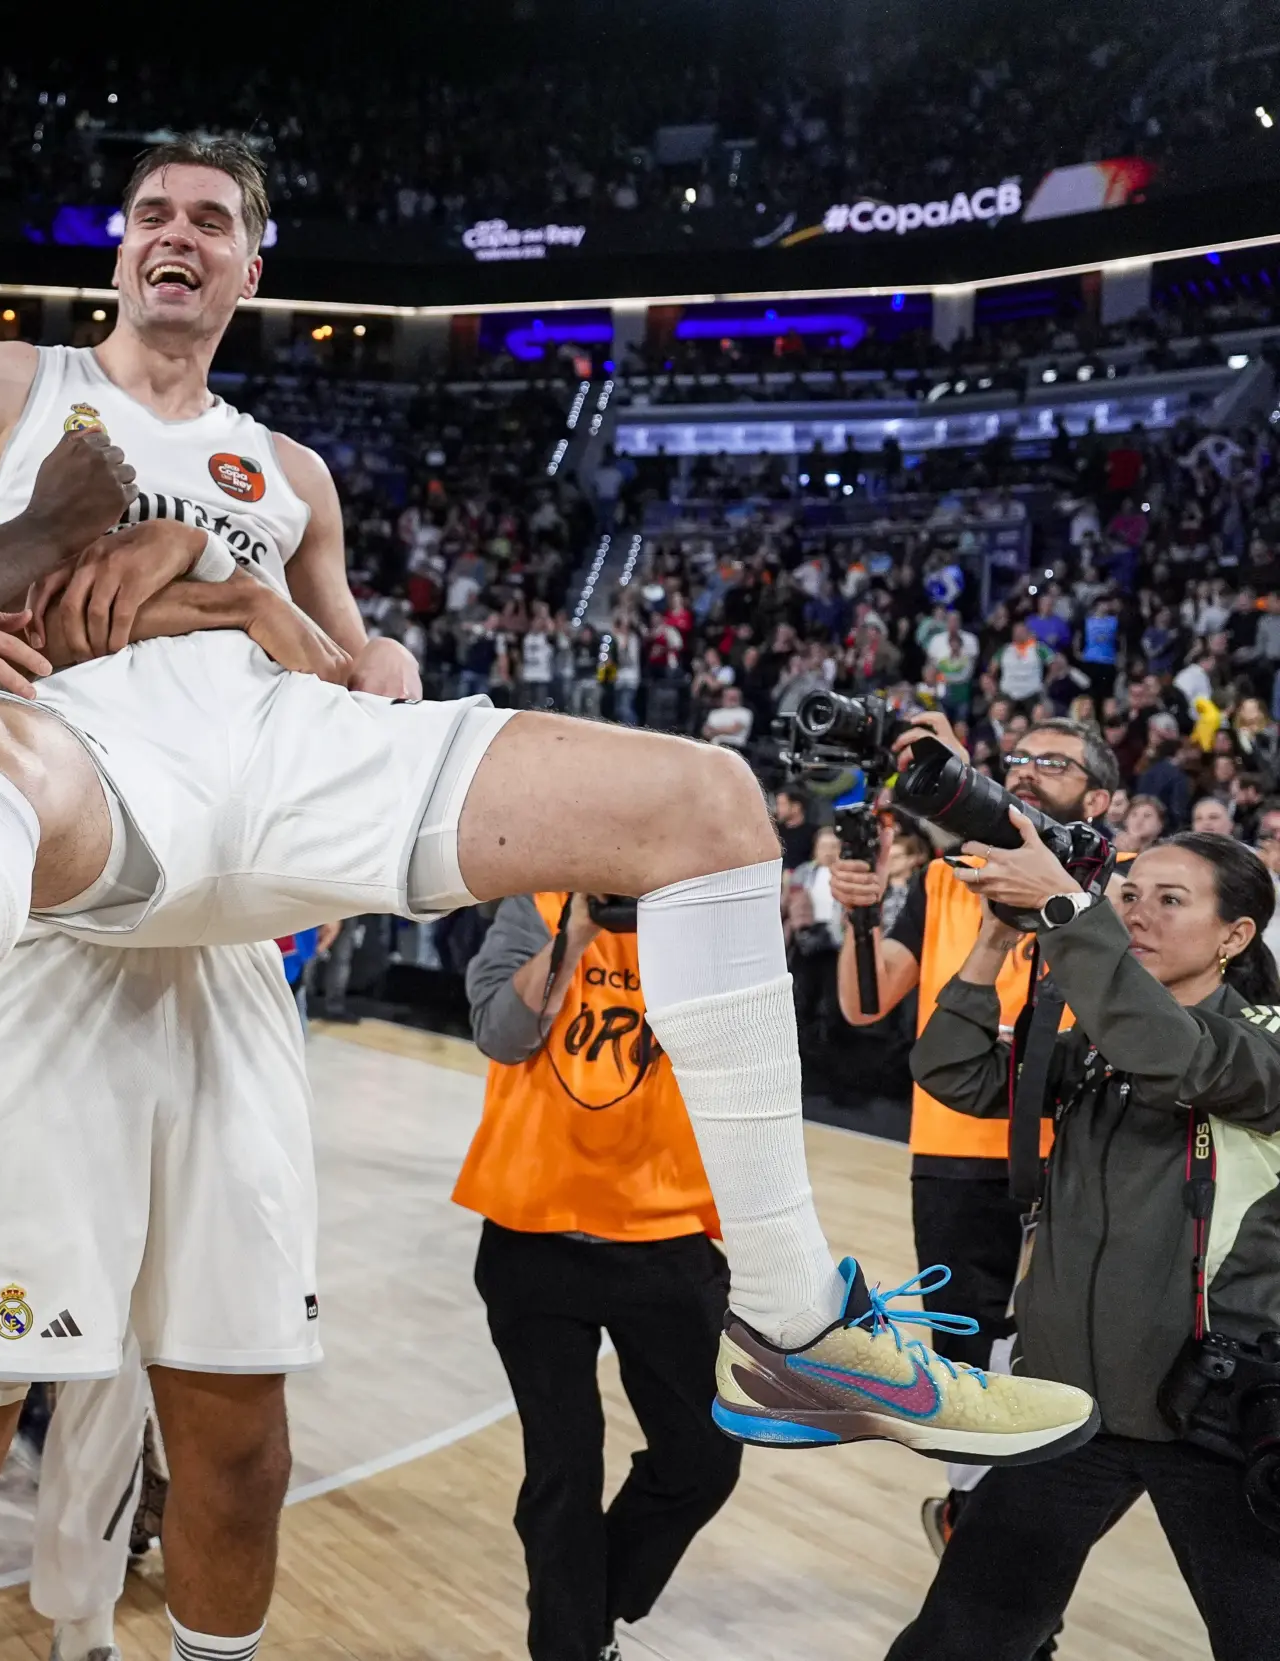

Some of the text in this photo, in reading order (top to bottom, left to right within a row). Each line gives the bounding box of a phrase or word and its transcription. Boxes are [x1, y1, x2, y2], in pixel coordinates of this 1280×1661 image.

[823, 182, 1022, 236] #CopaACB
[585, 966, 641, 991] acb
[1195, 1122, 1210, 1160] EOS
